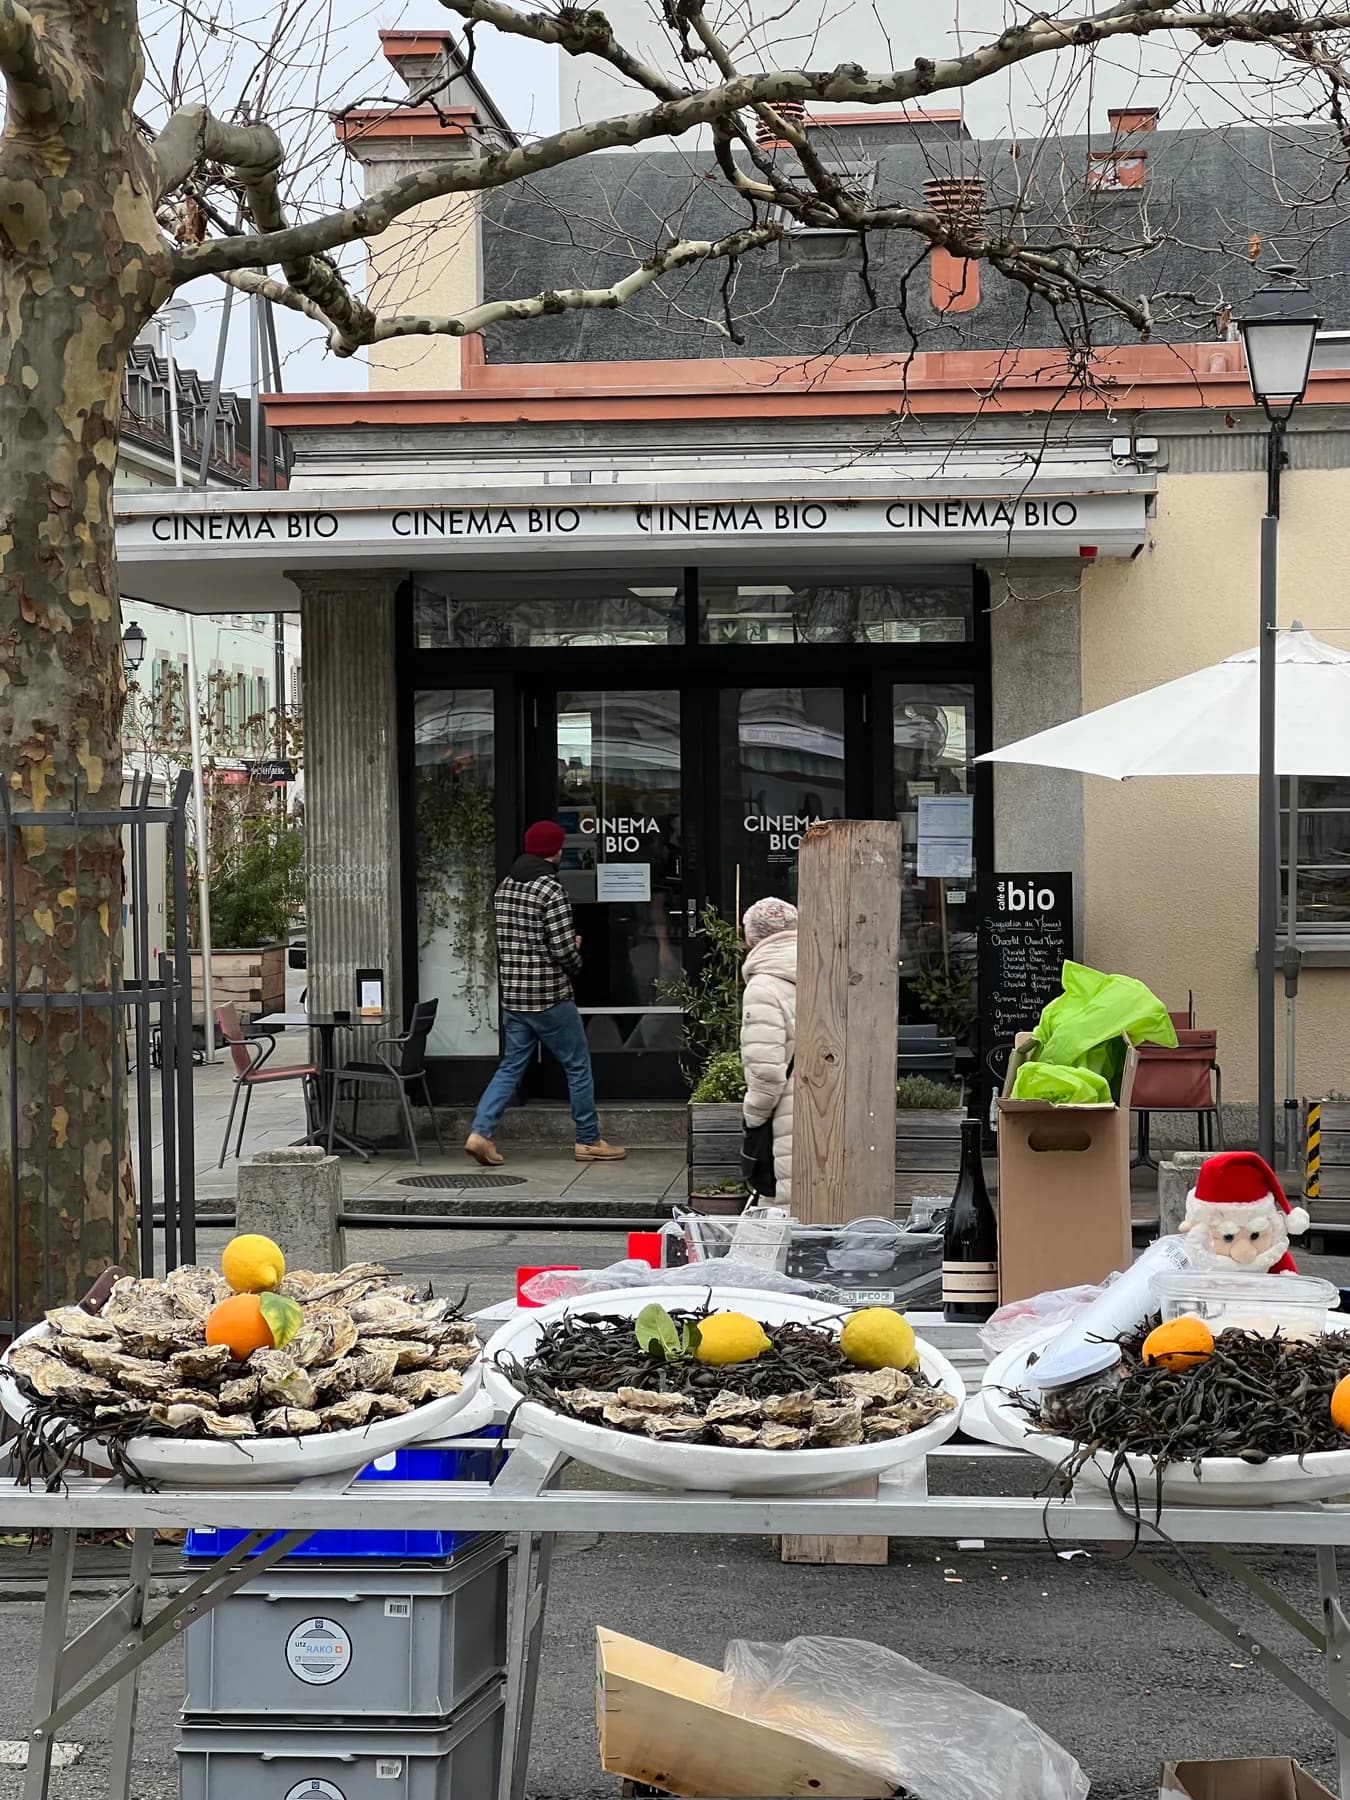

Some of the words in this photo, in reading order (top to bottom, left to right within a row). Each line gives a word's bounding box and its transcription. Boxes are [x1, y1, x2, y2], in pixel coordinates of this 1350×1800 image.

[391, 510, 517, 536] CINEMA
[527, 507, 580, 533] BIO
[636, 505, 764, 531] CINEMA
[774, 503, 827, 530] BIO
[885, 502, 1013, 529] CINEMA
[1024, 501, 1078, 527] BIO
[152, 514, 275, 541] CINEMA
[287, 512, 339, 538] BIO
[579, 817, 660, 834] CINEMA
[606, 836, 640, 852] BIO
[769, 834, 802, 851] BIO
[997, 881, 1005, 892] du
[1008, 881, 1055, 911] bio
[858, 1292, 881, 1300] IFCO
[306, 1645, 333, 1654] RAKO
